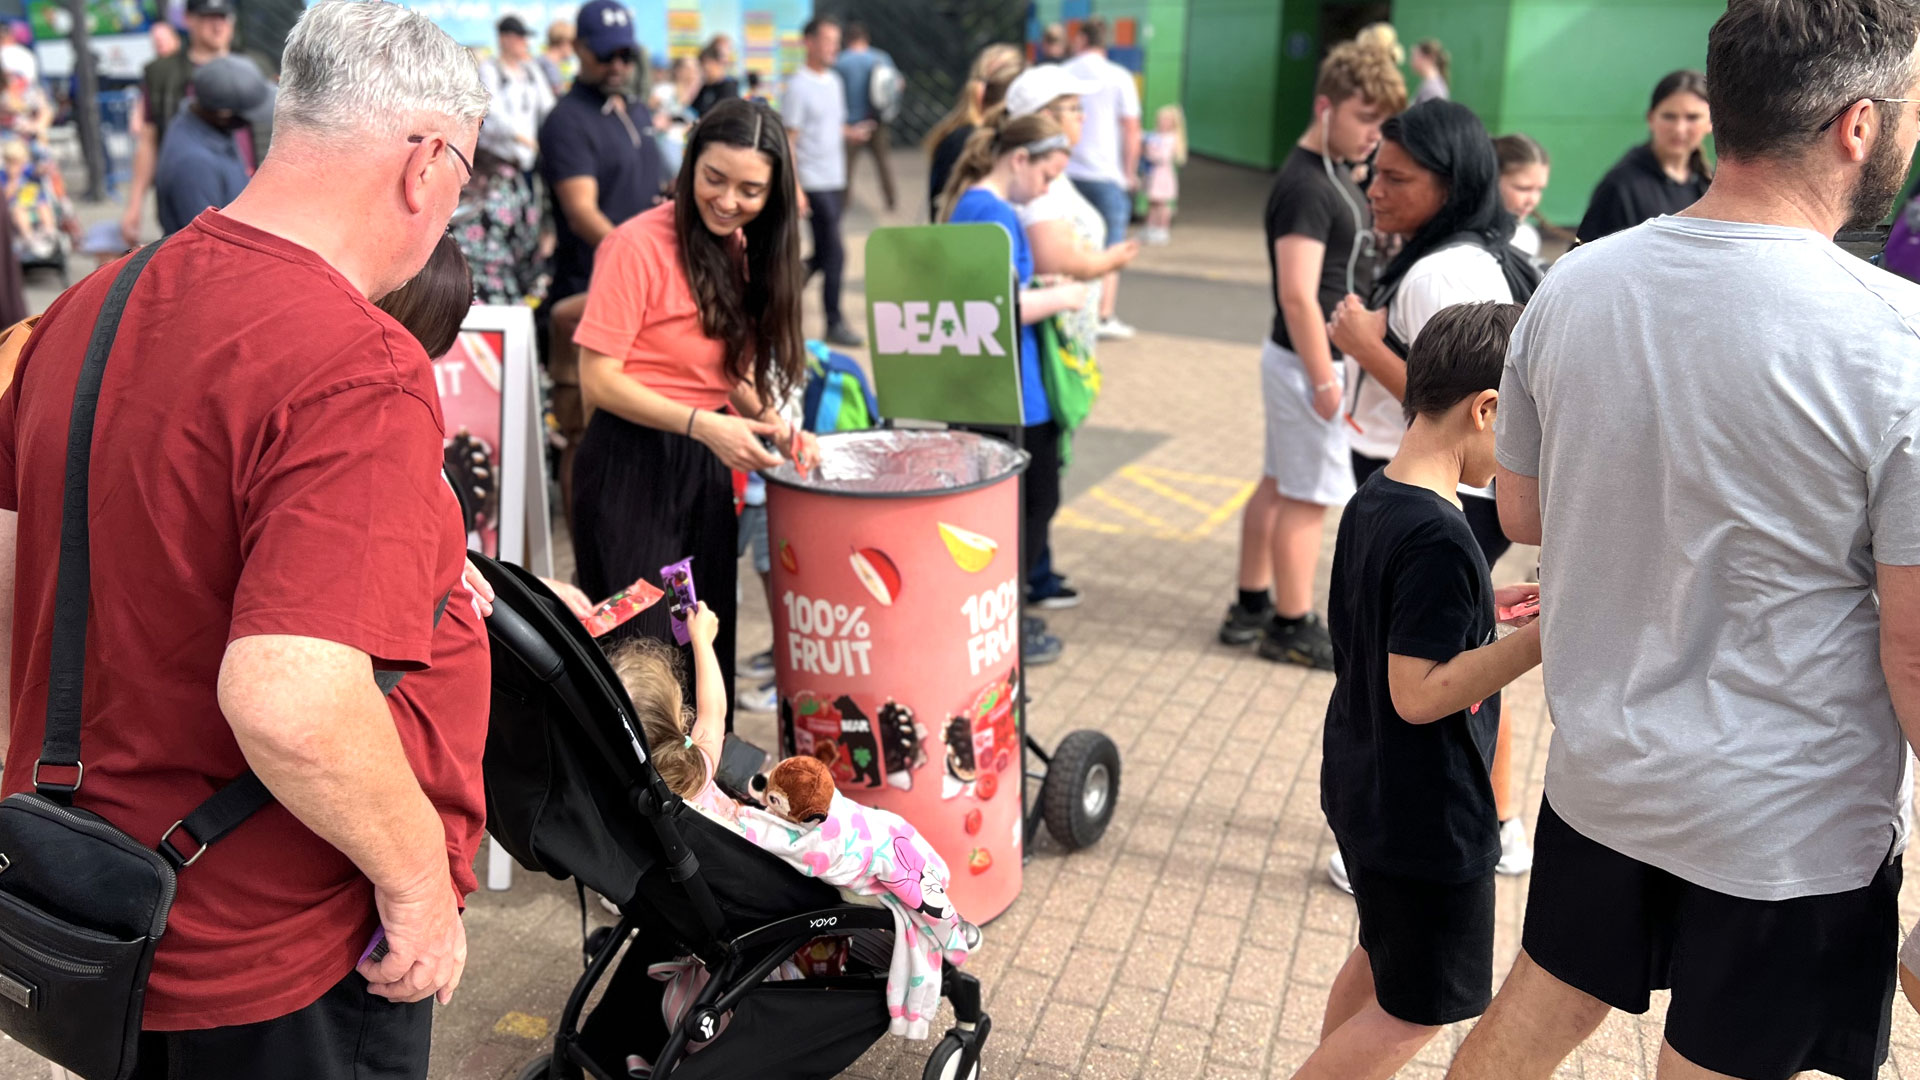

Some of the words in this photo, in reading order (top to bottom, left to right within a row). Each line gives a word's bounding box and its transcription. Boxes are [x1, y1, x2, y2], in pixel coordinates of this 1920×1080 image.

[873, 301, 1006, 356] BEAR
[783, 590, 870, 638] 100%
[788, 631, 872, 677] FRUIT
[810, 916, 837, 928] YOYO
